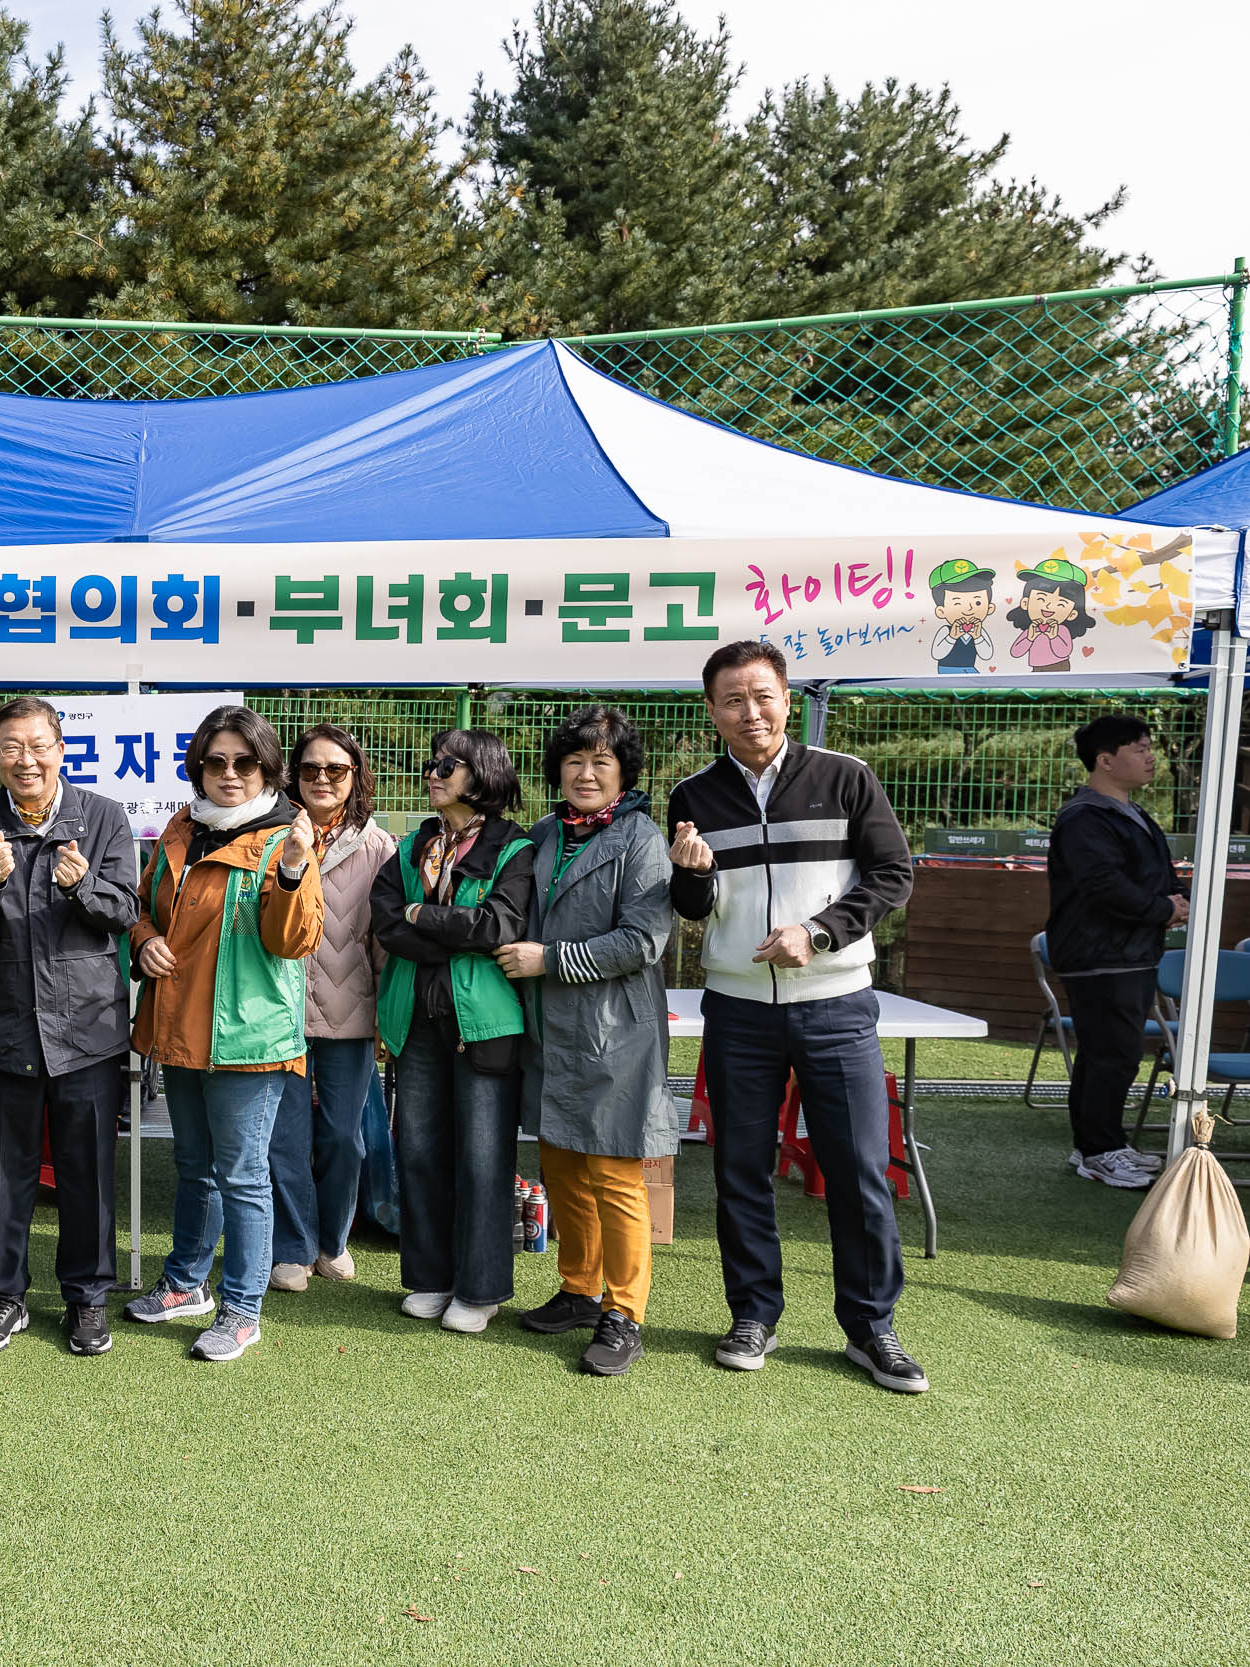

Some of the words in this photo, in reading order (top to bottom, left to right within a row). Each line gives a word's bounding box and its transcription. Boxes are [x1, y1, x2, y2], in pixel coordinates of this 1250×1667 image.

[745, 546, 915, 625] 화이팅!
[783, 629, 808, 660] 잘
[68, 712, 93, 720] 광진구
